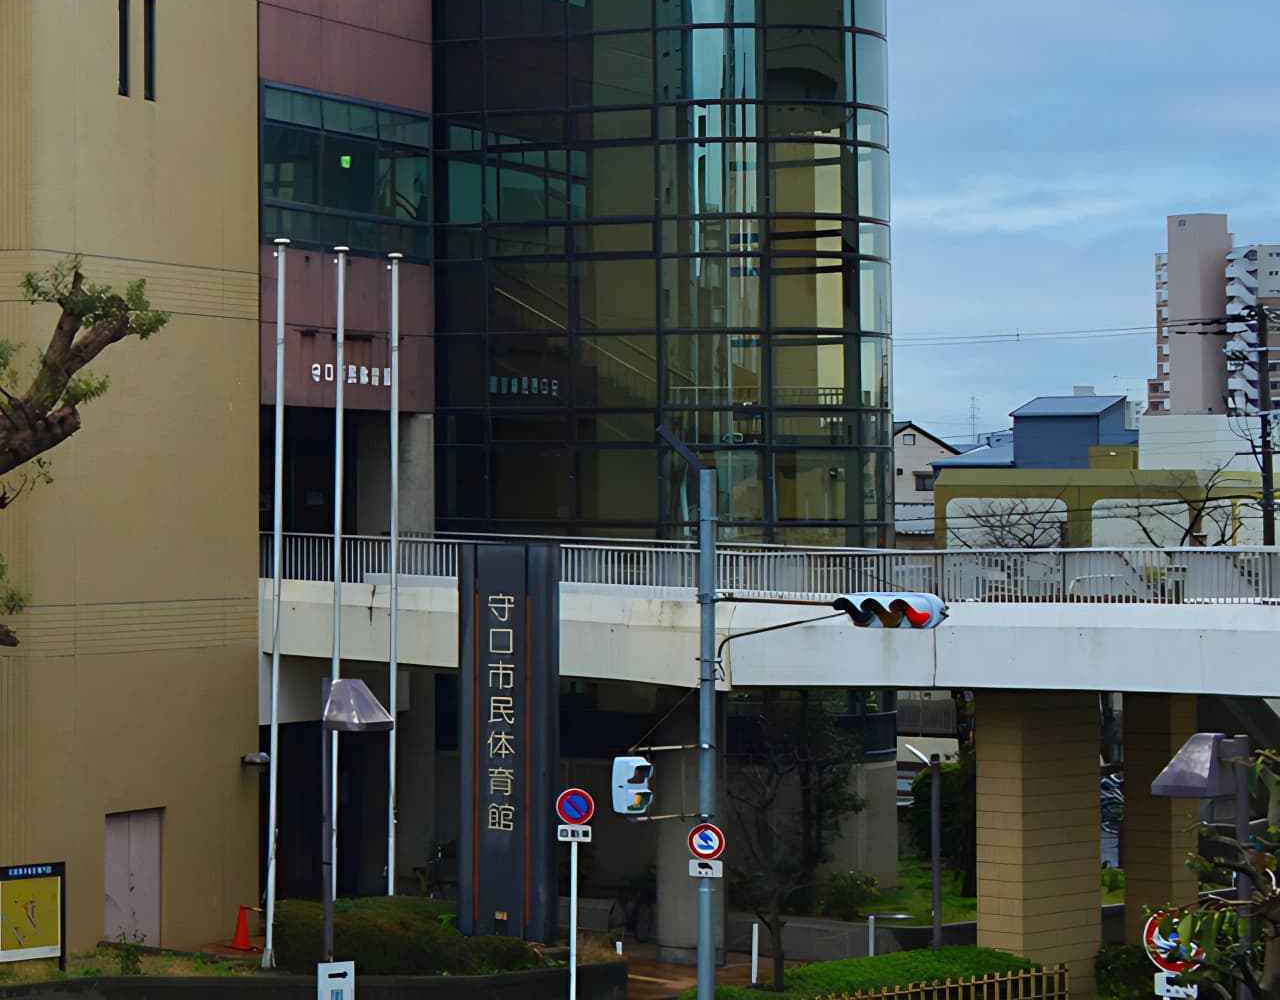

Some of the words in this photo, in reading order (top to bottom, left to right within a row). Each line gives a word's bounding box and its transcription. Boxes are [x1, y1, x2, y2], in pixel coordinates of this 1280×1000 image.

[487, 592, 516, 832] 守口市民体育館
